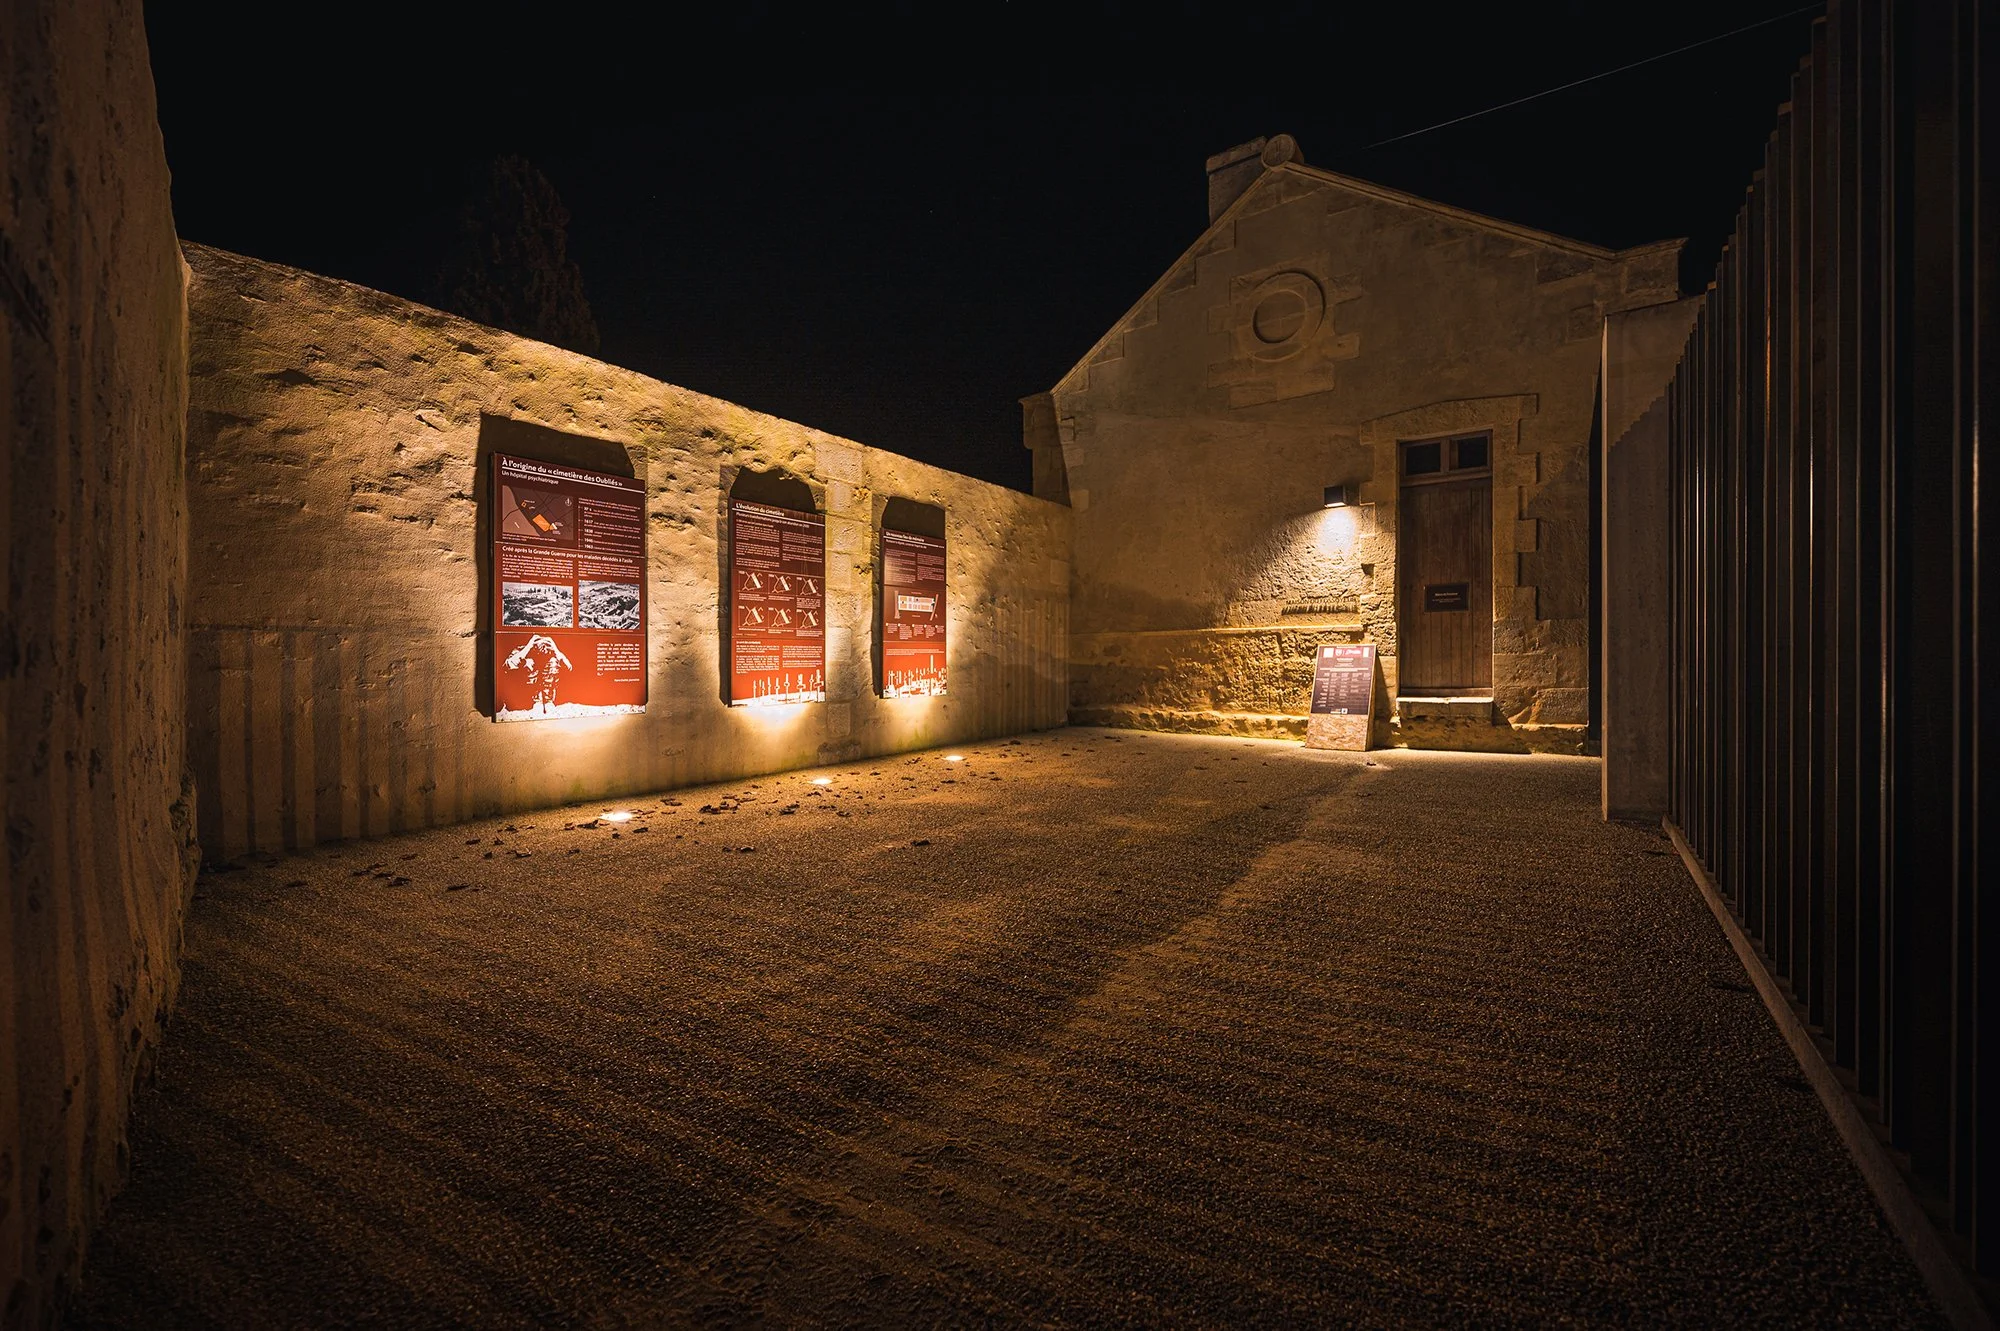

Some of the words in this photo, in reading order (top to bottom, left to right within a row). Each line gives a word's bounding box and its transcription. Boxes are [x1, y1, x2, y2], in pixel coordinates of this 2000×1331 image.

[502, 457, 508, 466] À
[509, 460, 537, 471] l'origine
[553, 469, 583, 480] cimetière
[584, 474, 595, 482] des
[595, 476, 618, 486] Oubliés
[510, 471, 527, 479] hôpital
[528, 475, 559, 485] psychiatrique
